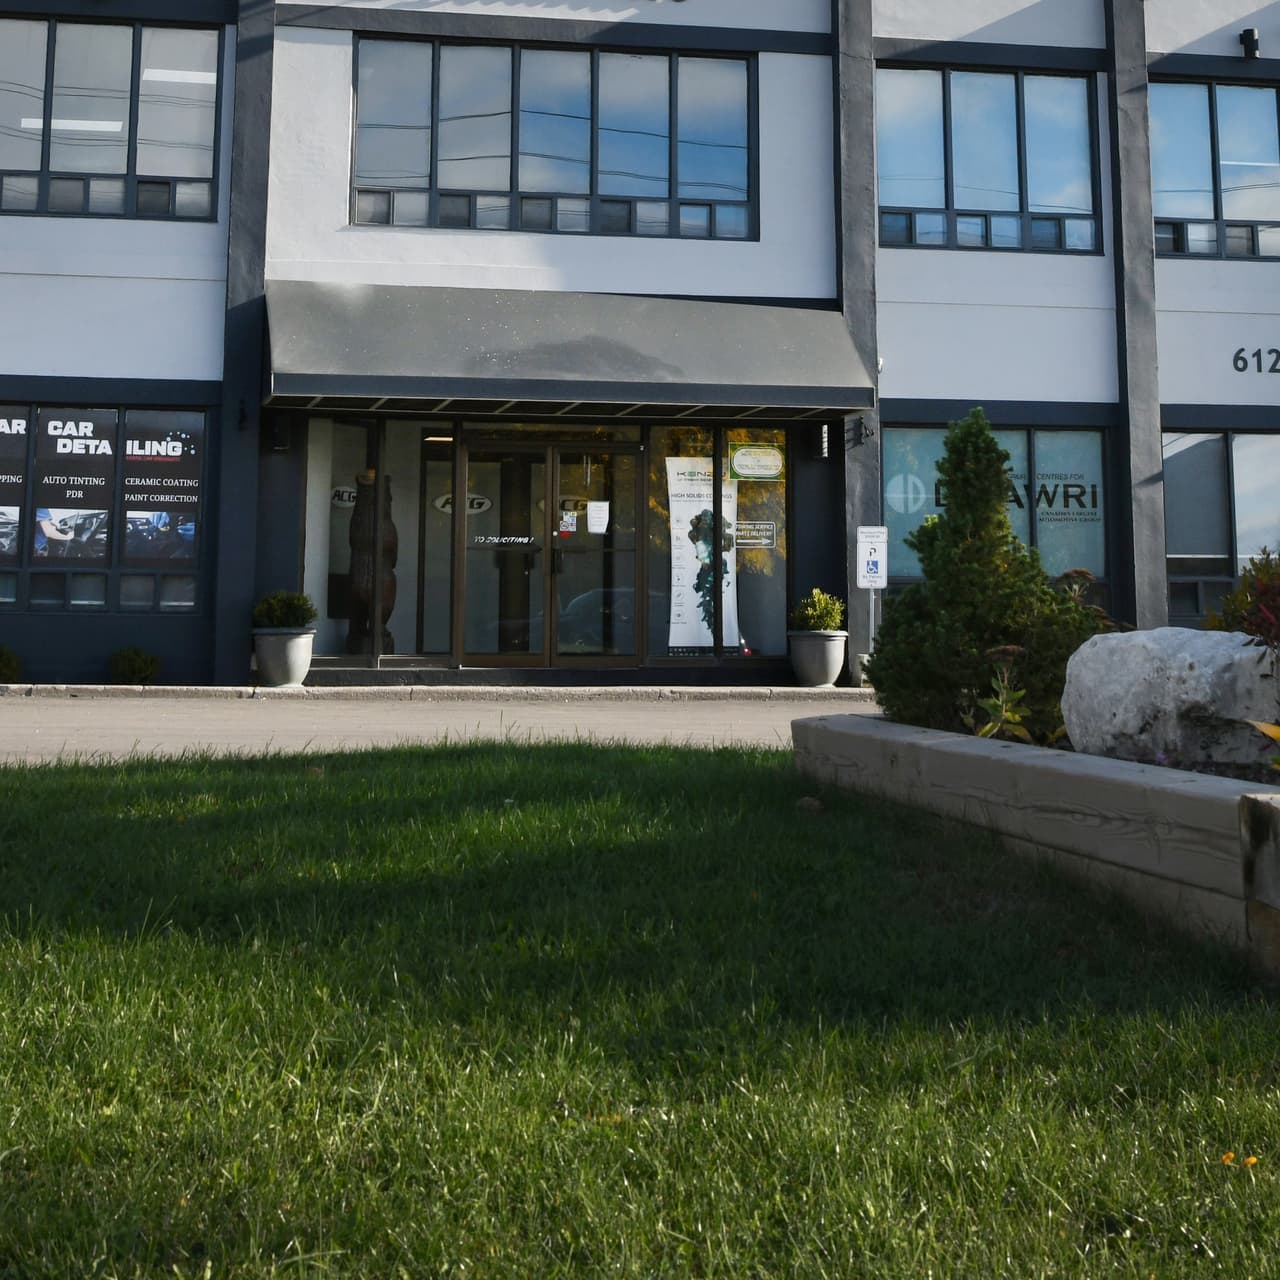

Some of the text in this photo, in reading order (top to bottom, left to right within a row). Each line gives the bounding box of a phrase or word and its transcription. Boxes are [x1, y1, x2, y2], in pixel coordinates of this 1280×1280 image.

[47, 420, 94, 437] CAR
[42, 475, 106, 486] AUTO TINTING
[124, 477, 199, 487] CERAMIC COATING
[66, 490, 84, 498] PDR
[124, 493, 199, 503] PAINT CORRECTION
[440, 497, 487, 510] AG
